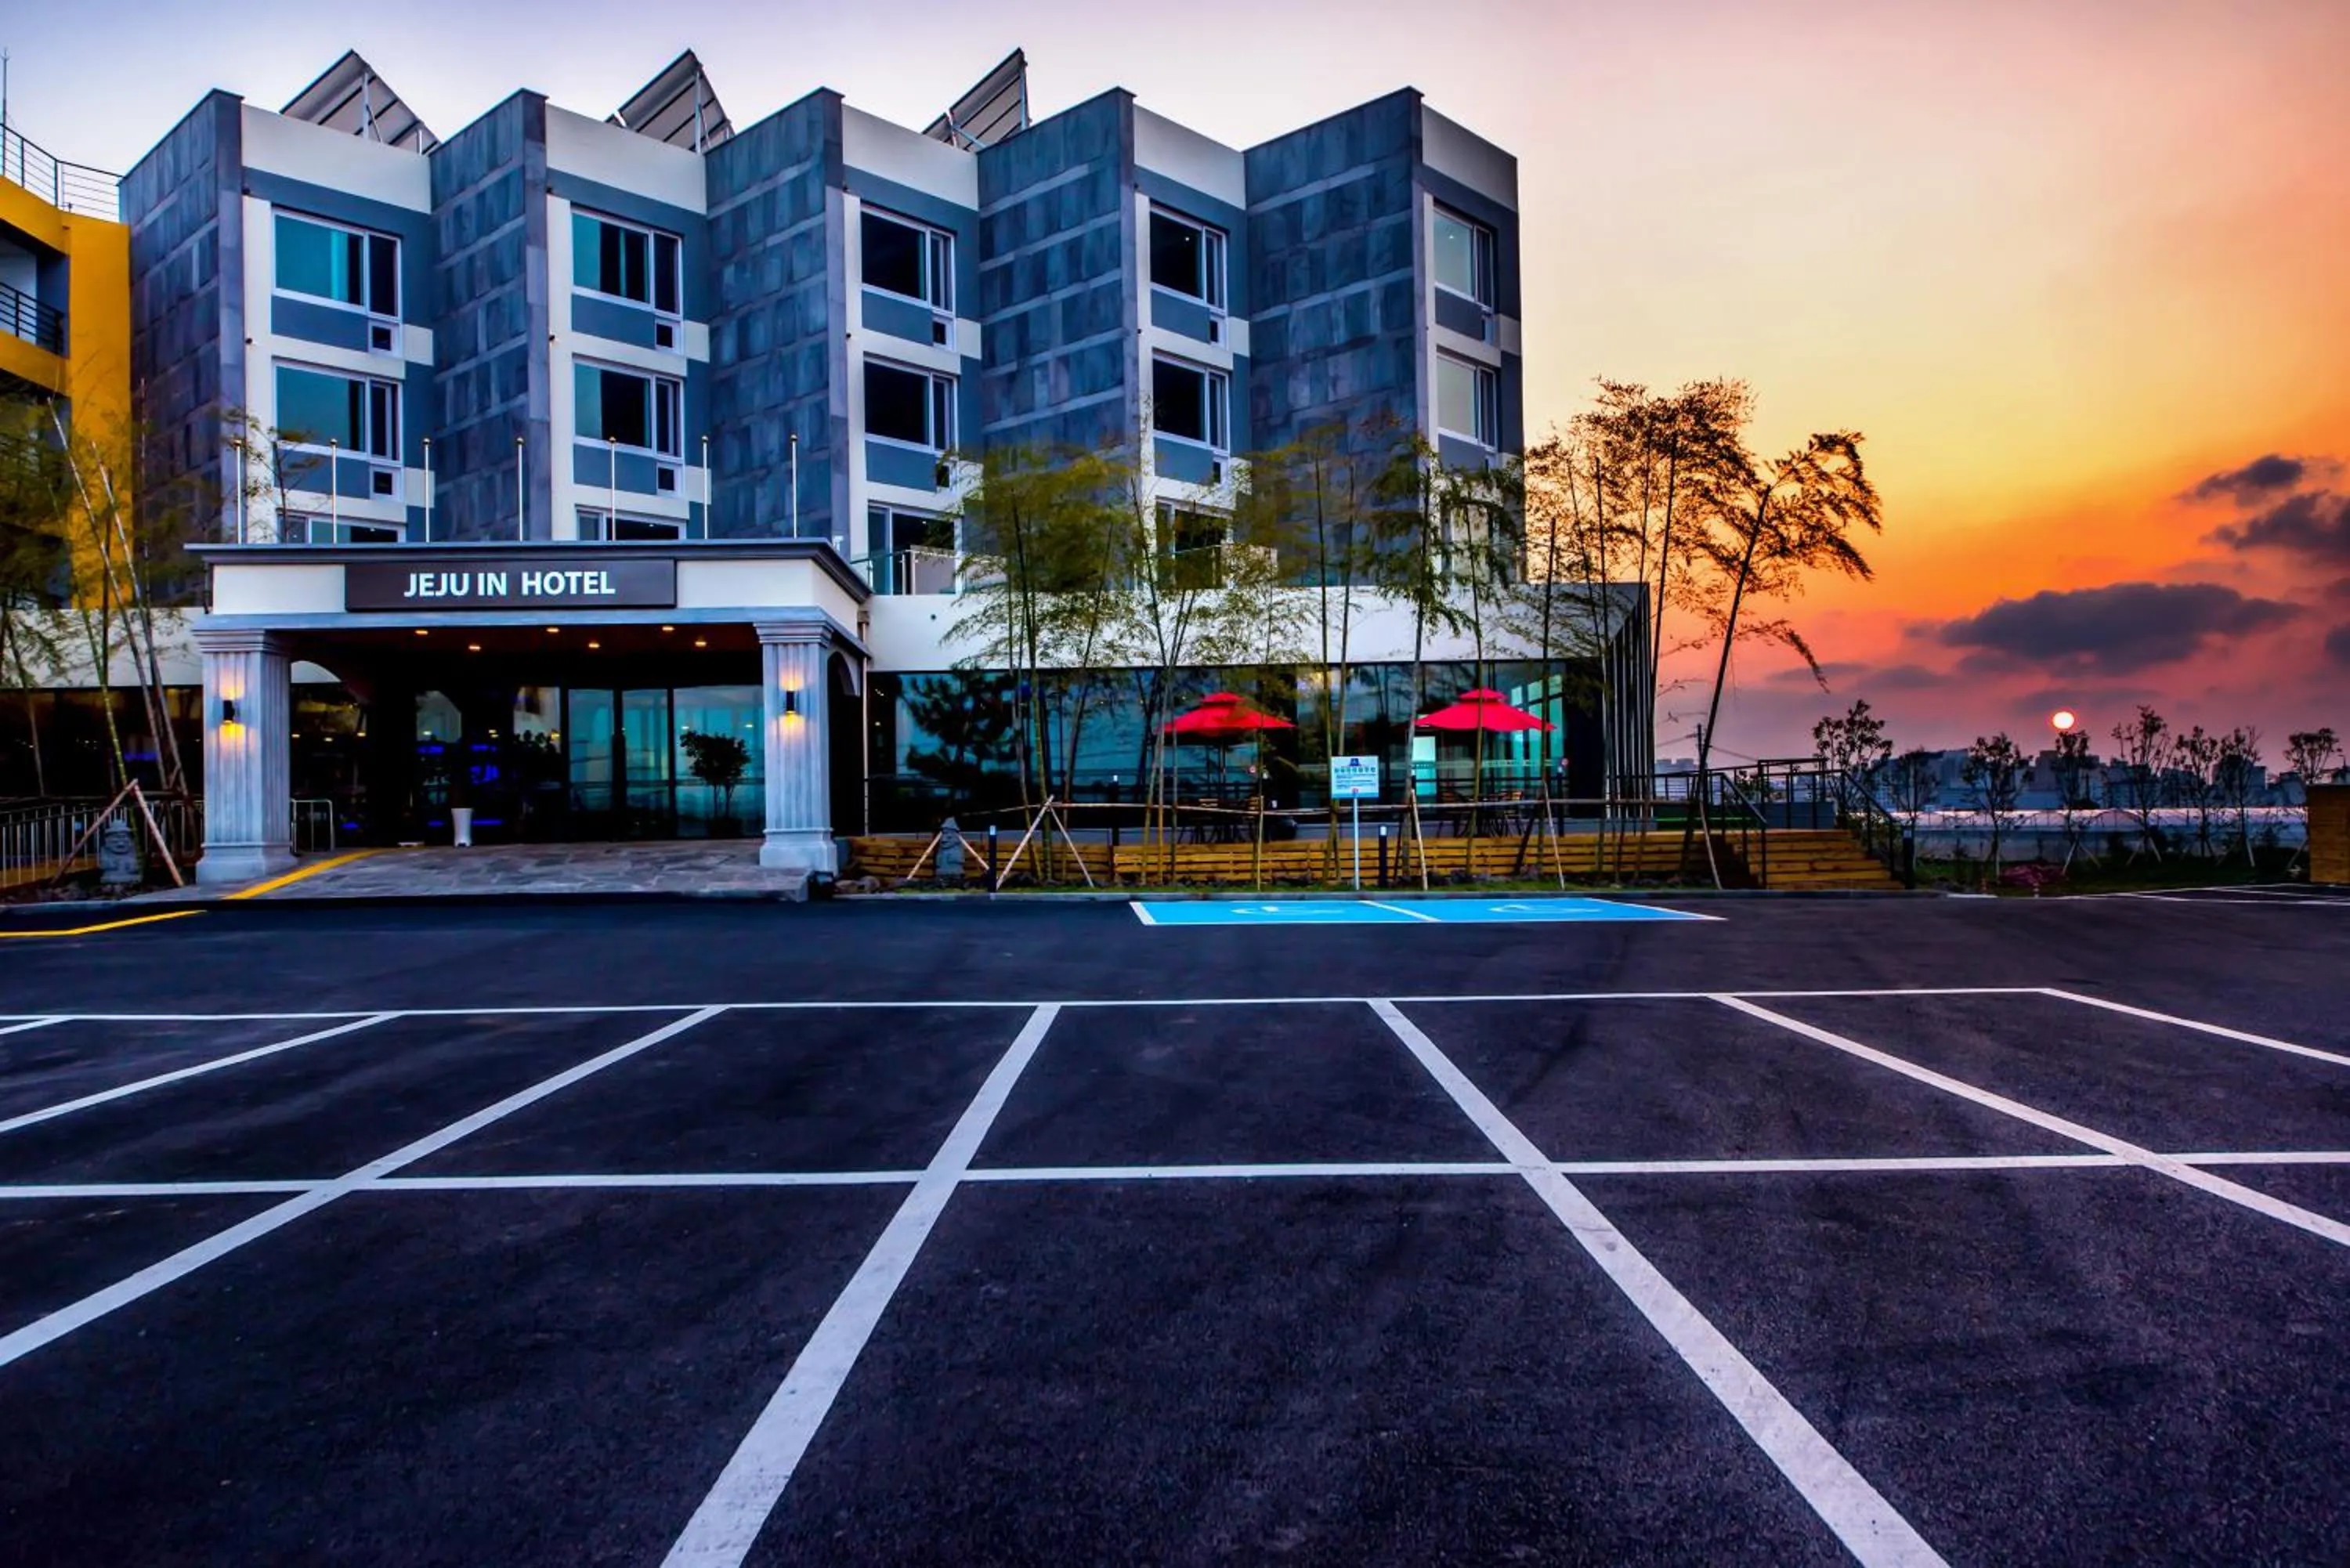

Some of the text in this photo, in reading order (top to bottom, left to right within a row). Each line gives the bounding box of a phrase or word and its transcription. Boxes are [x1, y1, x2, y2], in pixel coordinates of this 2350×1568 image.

[404, 571, 616, 597] JEJU IN HOTEL
